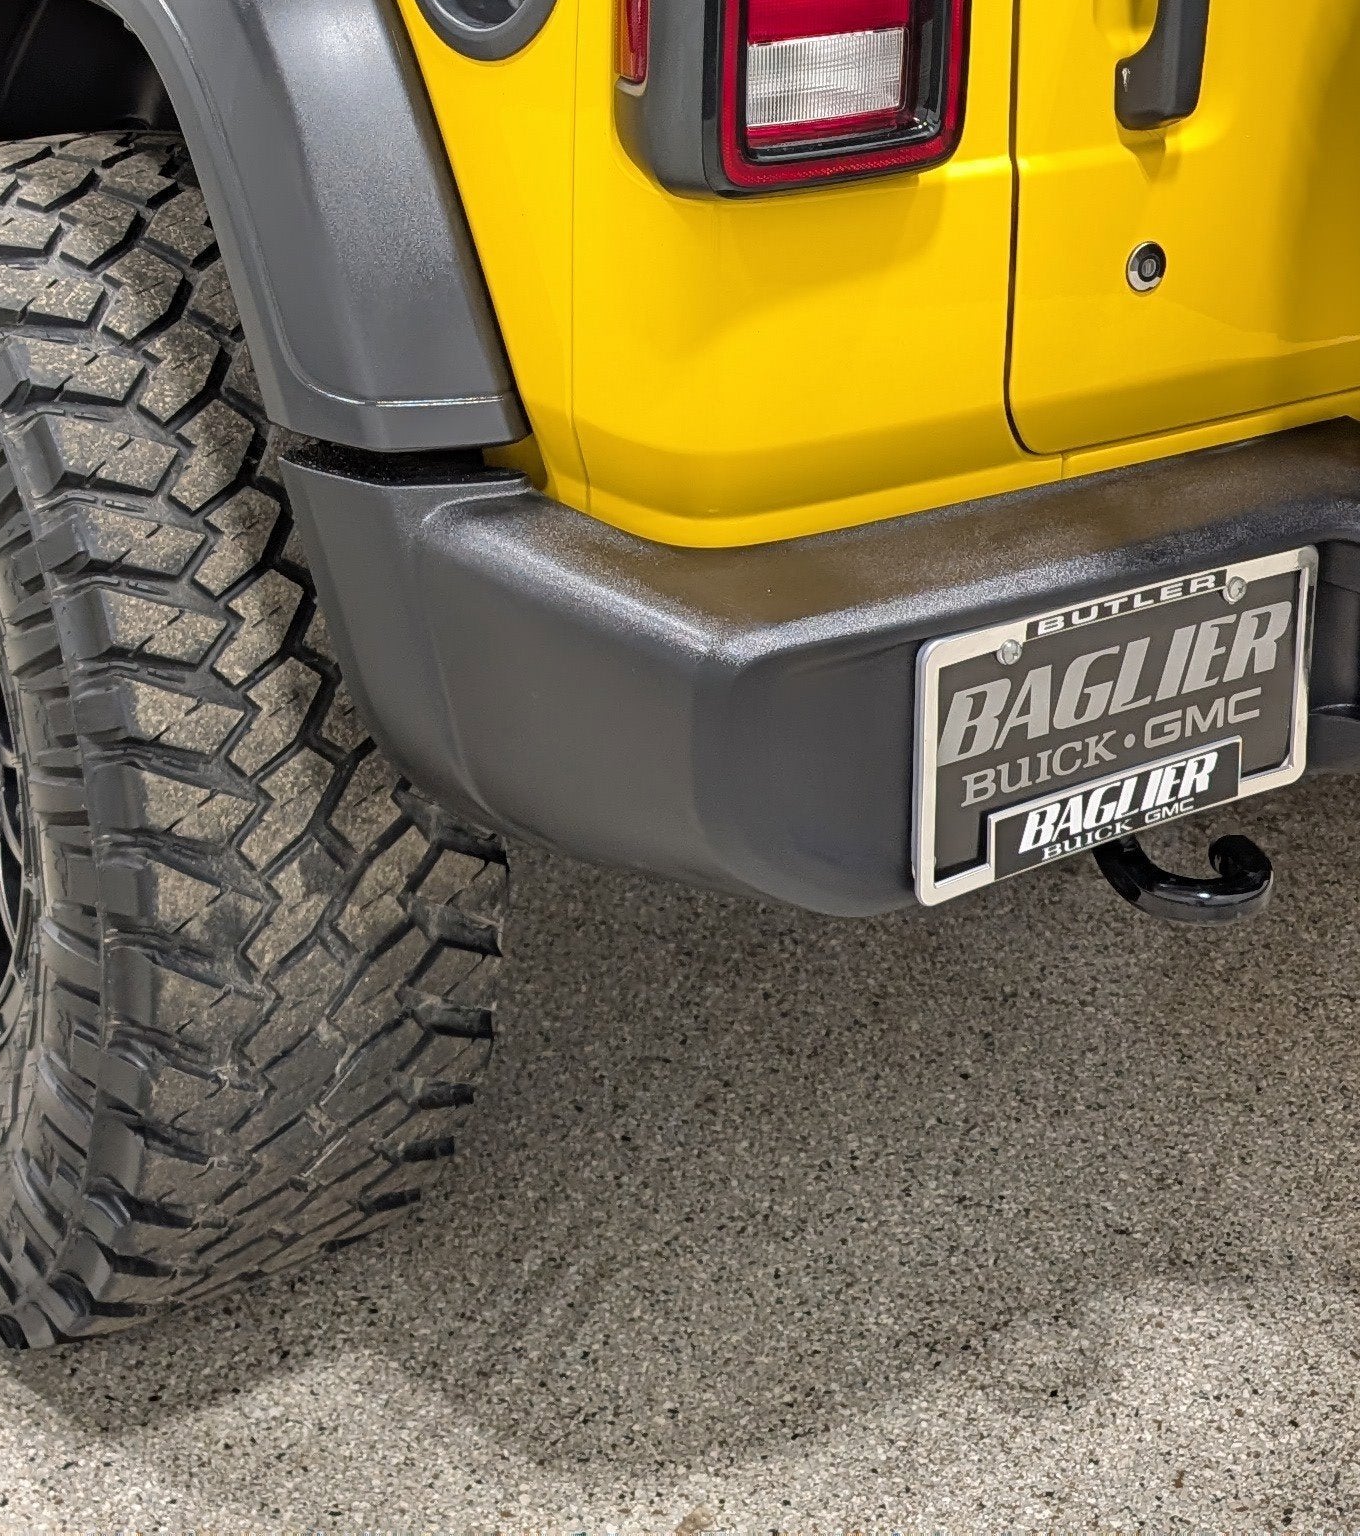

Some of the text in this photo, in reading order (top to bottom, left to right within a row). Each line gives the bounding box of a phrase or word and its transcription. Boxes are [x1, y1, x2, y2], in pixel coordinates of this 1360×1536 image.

[1037, 574, 1216, 635] BUTLER
[937, 601, 1292, 768] BAGLIER
[961, 687, 1262, 808] BUICK GMC
[1018, 751, 1218, 855] BAGLIER
[1041, 797, 1195, 862] BUICK GMC
